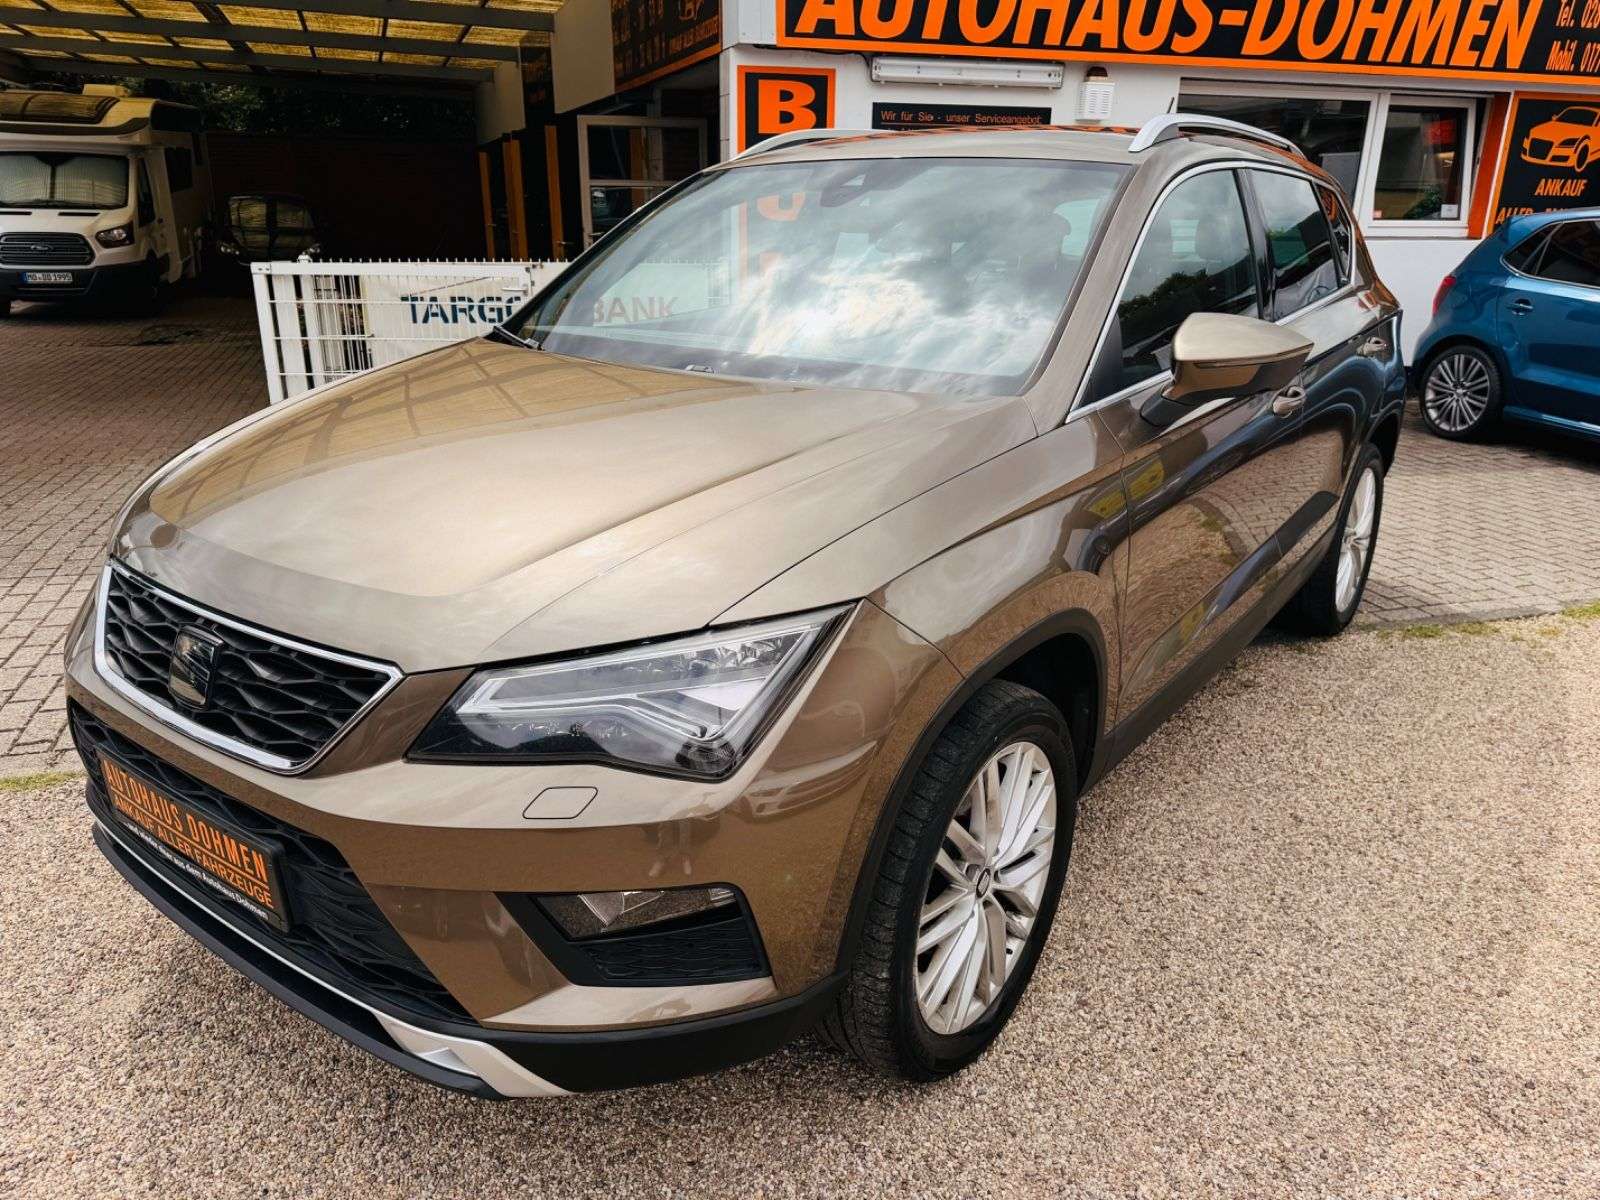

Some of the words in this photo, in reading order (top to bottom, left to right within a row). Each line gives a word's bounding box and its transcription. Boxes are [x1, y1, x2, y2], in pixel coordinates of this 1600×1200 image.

[881, 110, 896, 121] Wir
[901, 110, 913, 121] für
[918, 111, 934, 122] Sie
[946, 113, 970, 123] unser
[1534, 178, 1588, 196] ANKAUF
[103, 759, 184, 832] AUTOHAUS
[186, 813, 268, 882] DOHMEN
[114, 794, 155, 833] ANKAUF
[156, 825, 194, 860] ALLER
[194, 848, 274, 909] FAHRZEUGE
